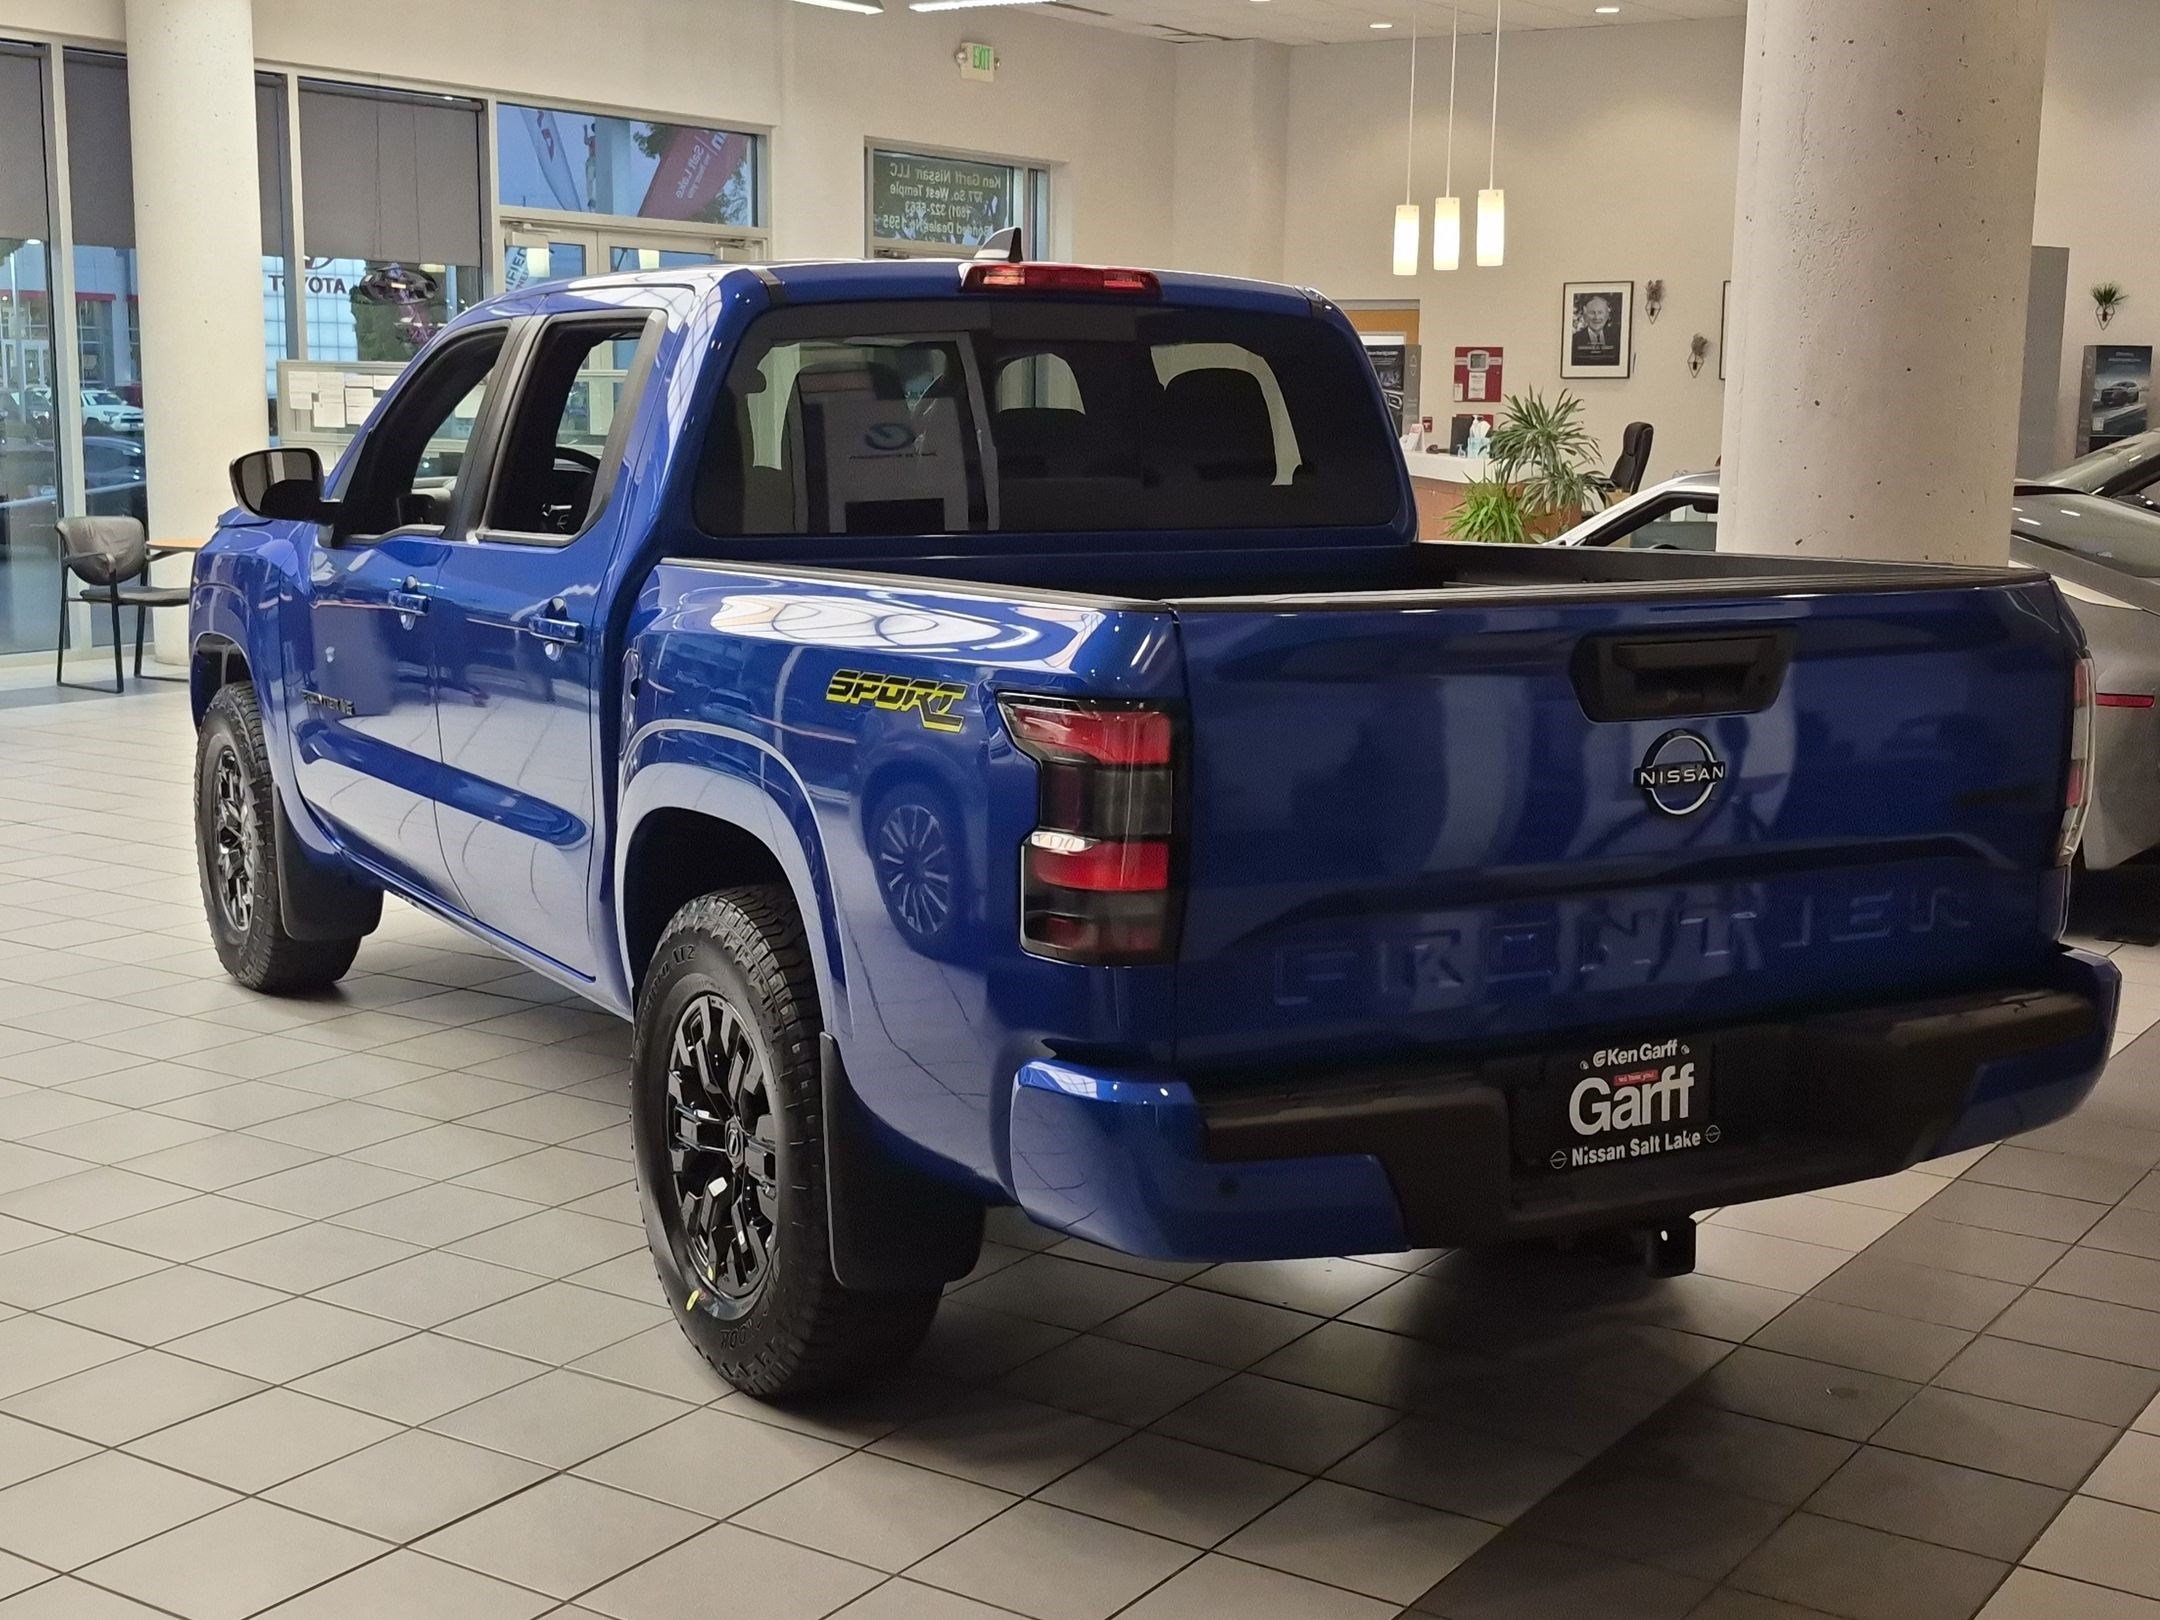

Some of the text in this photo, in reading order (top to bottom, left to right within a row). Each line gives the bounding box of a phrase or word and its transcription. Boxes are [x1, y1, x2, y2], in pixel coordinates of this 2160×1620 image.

[973, 45, 991, 70] EXIT
[267, 274, 347, 294] TOTA
[825, 669, 969, 734] SPORT
[1640, 765, 1725, 785] NISSAN
[1272, 885, 1974, 1008] FRONTIER
[1607, 1039, 1678, 1066] Ken Garff
[1569, 1063, 1695, 1136] Garff
[1572, 1130, 1702, 1167] Nissan Salt Lake
